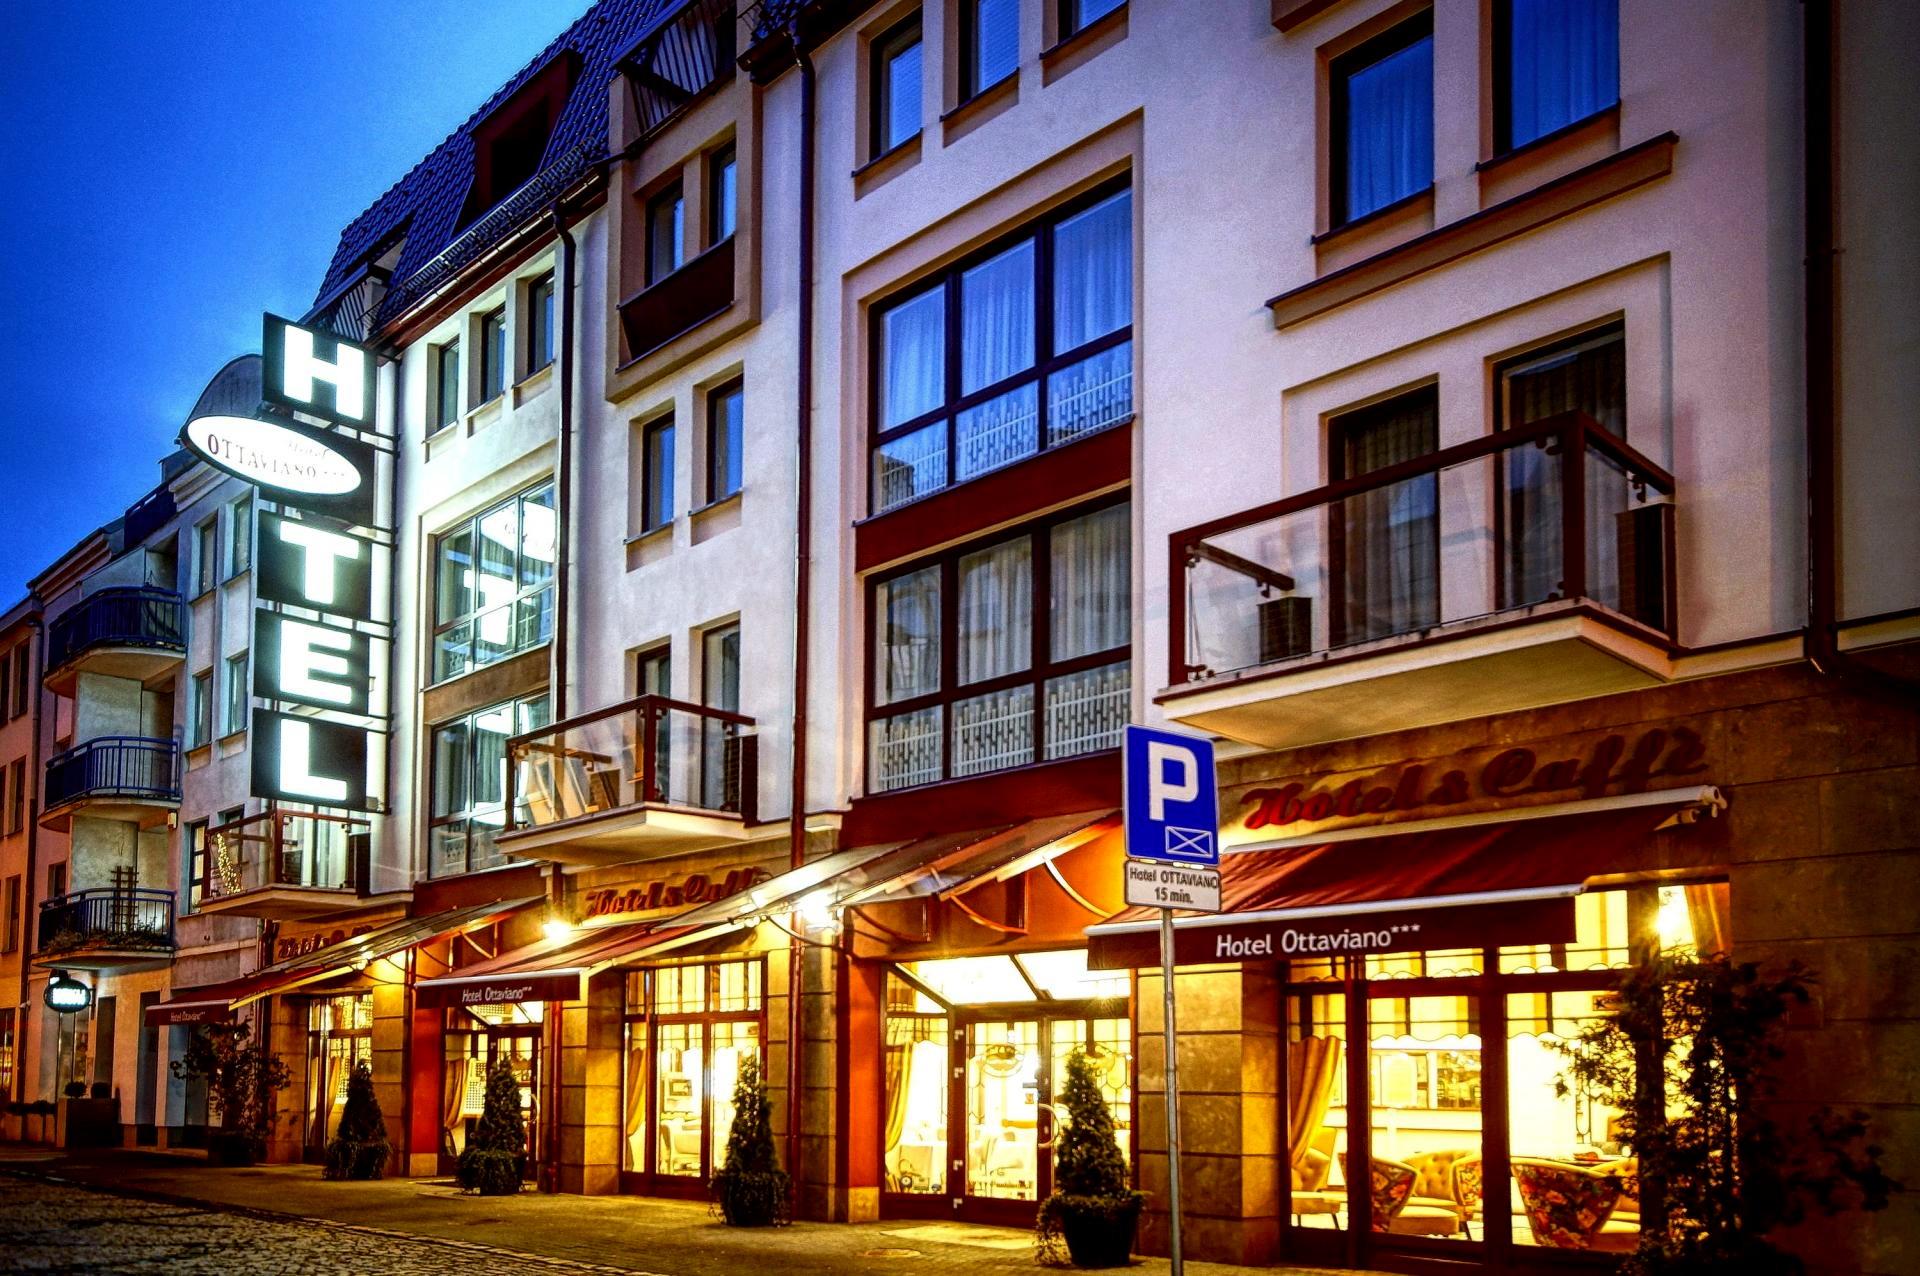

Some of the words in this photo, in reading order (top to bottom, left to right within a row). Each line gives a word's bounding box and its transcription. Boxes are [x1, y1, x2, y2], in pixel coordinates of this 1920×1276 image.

[207, 433, 317, 479] OTTAVIANO
[1148, 740, 1200, 821] P
[1241, 764, 1425, 829] Hotel
[1427, 770, 1470, 806] &
[1129, 867, 1157, 882] Hotel
[1160, 870, 1218, 889] OTTAVIANO
[584, 882, 665, 917] Hotel
[1154, 887, 1168, 901] 15
[1169, 889, 1194, 904] min.
[1215, 934, 1273, 957] Hotel
[1281, 929, 1392, 953] Ottaviano
[462, 988, 482, 1002] Hotel
